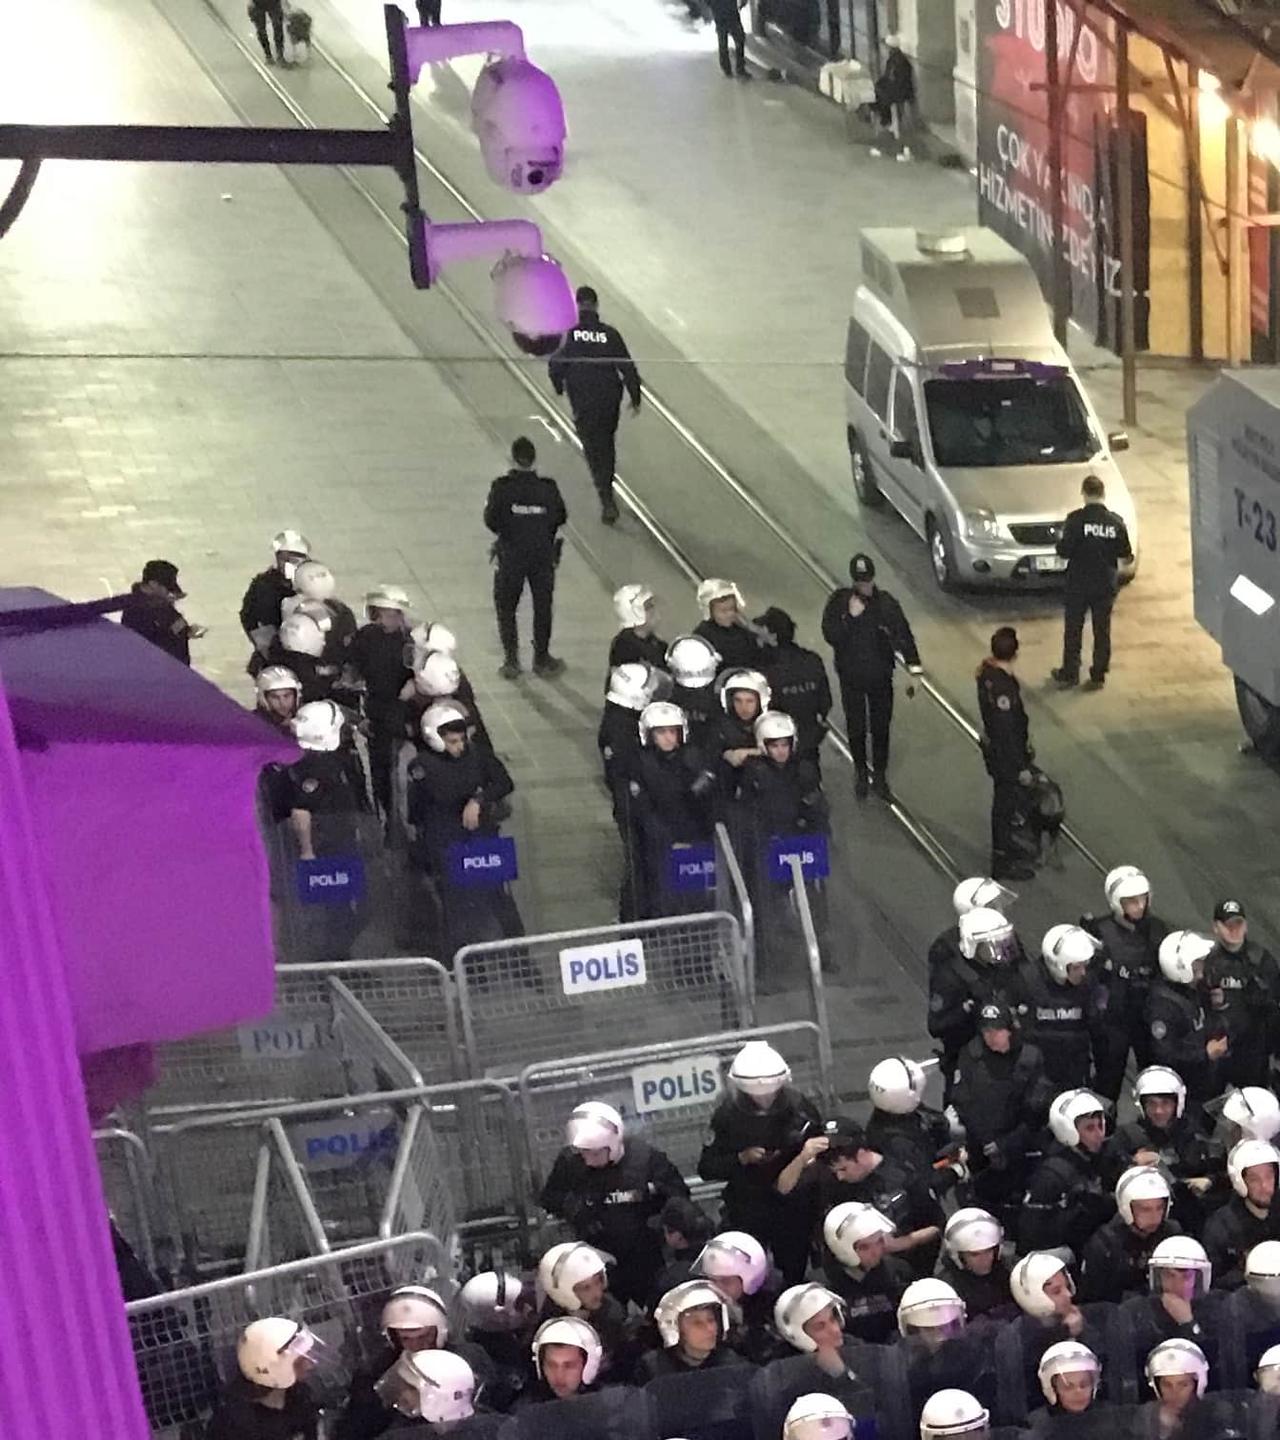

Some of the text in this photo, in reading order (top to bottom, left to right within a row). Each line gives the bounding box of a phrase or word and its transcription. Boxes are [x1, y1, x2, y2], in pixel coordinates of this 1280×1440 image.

[997, 123, 1031, 179] ÇOK
[1234, 486, 1278, 552] T-23
[309, 869, 350, 888] POLİS
[463, 852, 502, 870] POLİS
[569, 948, 639, 985] POLİS
[642, 1064, 717, 1106] POLİS
